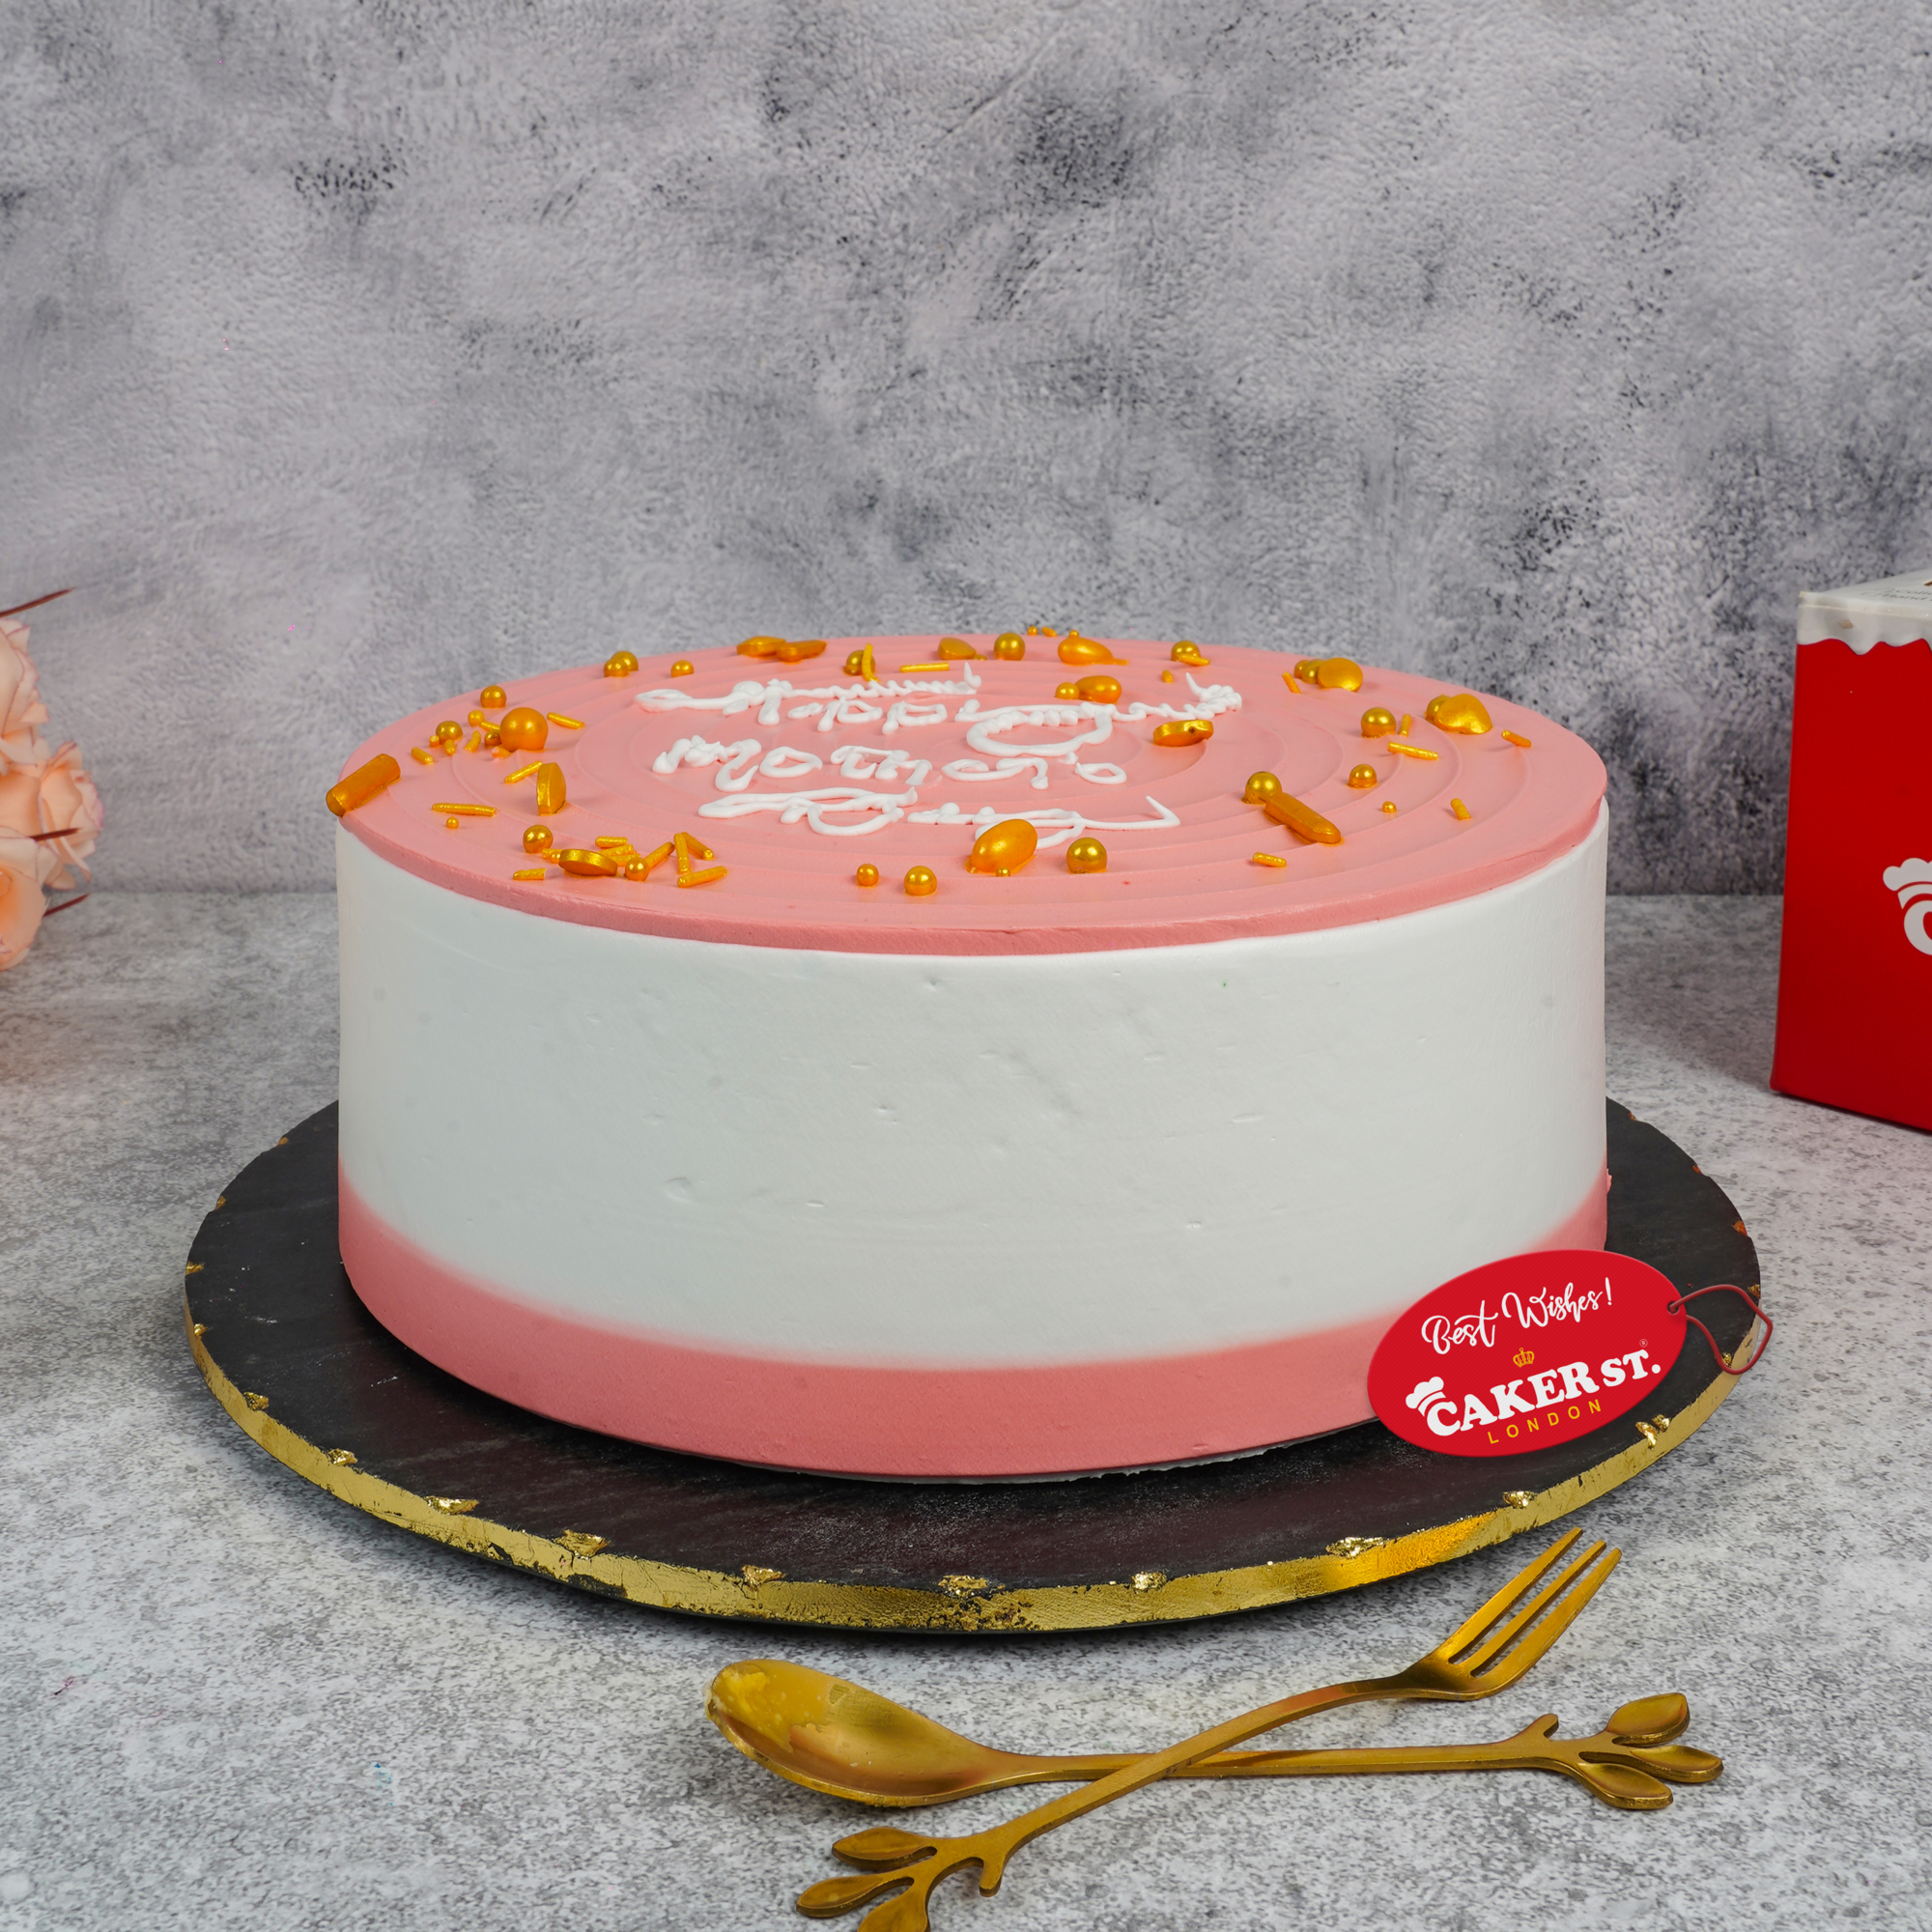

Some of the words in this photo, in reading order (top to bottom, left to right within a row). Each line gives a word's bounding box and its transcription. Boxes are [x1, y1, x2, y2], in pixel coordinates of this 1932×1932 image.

[1421, 1299, 1499, 1355] Best
[1501, 1276, 1613, 1329] Wishes!
[1426, 1360, 1601, 1436] CAKER
[1600, 1349, 1662, 1387] ST.
[1487, 1398, 1603, 1444] LONDON
